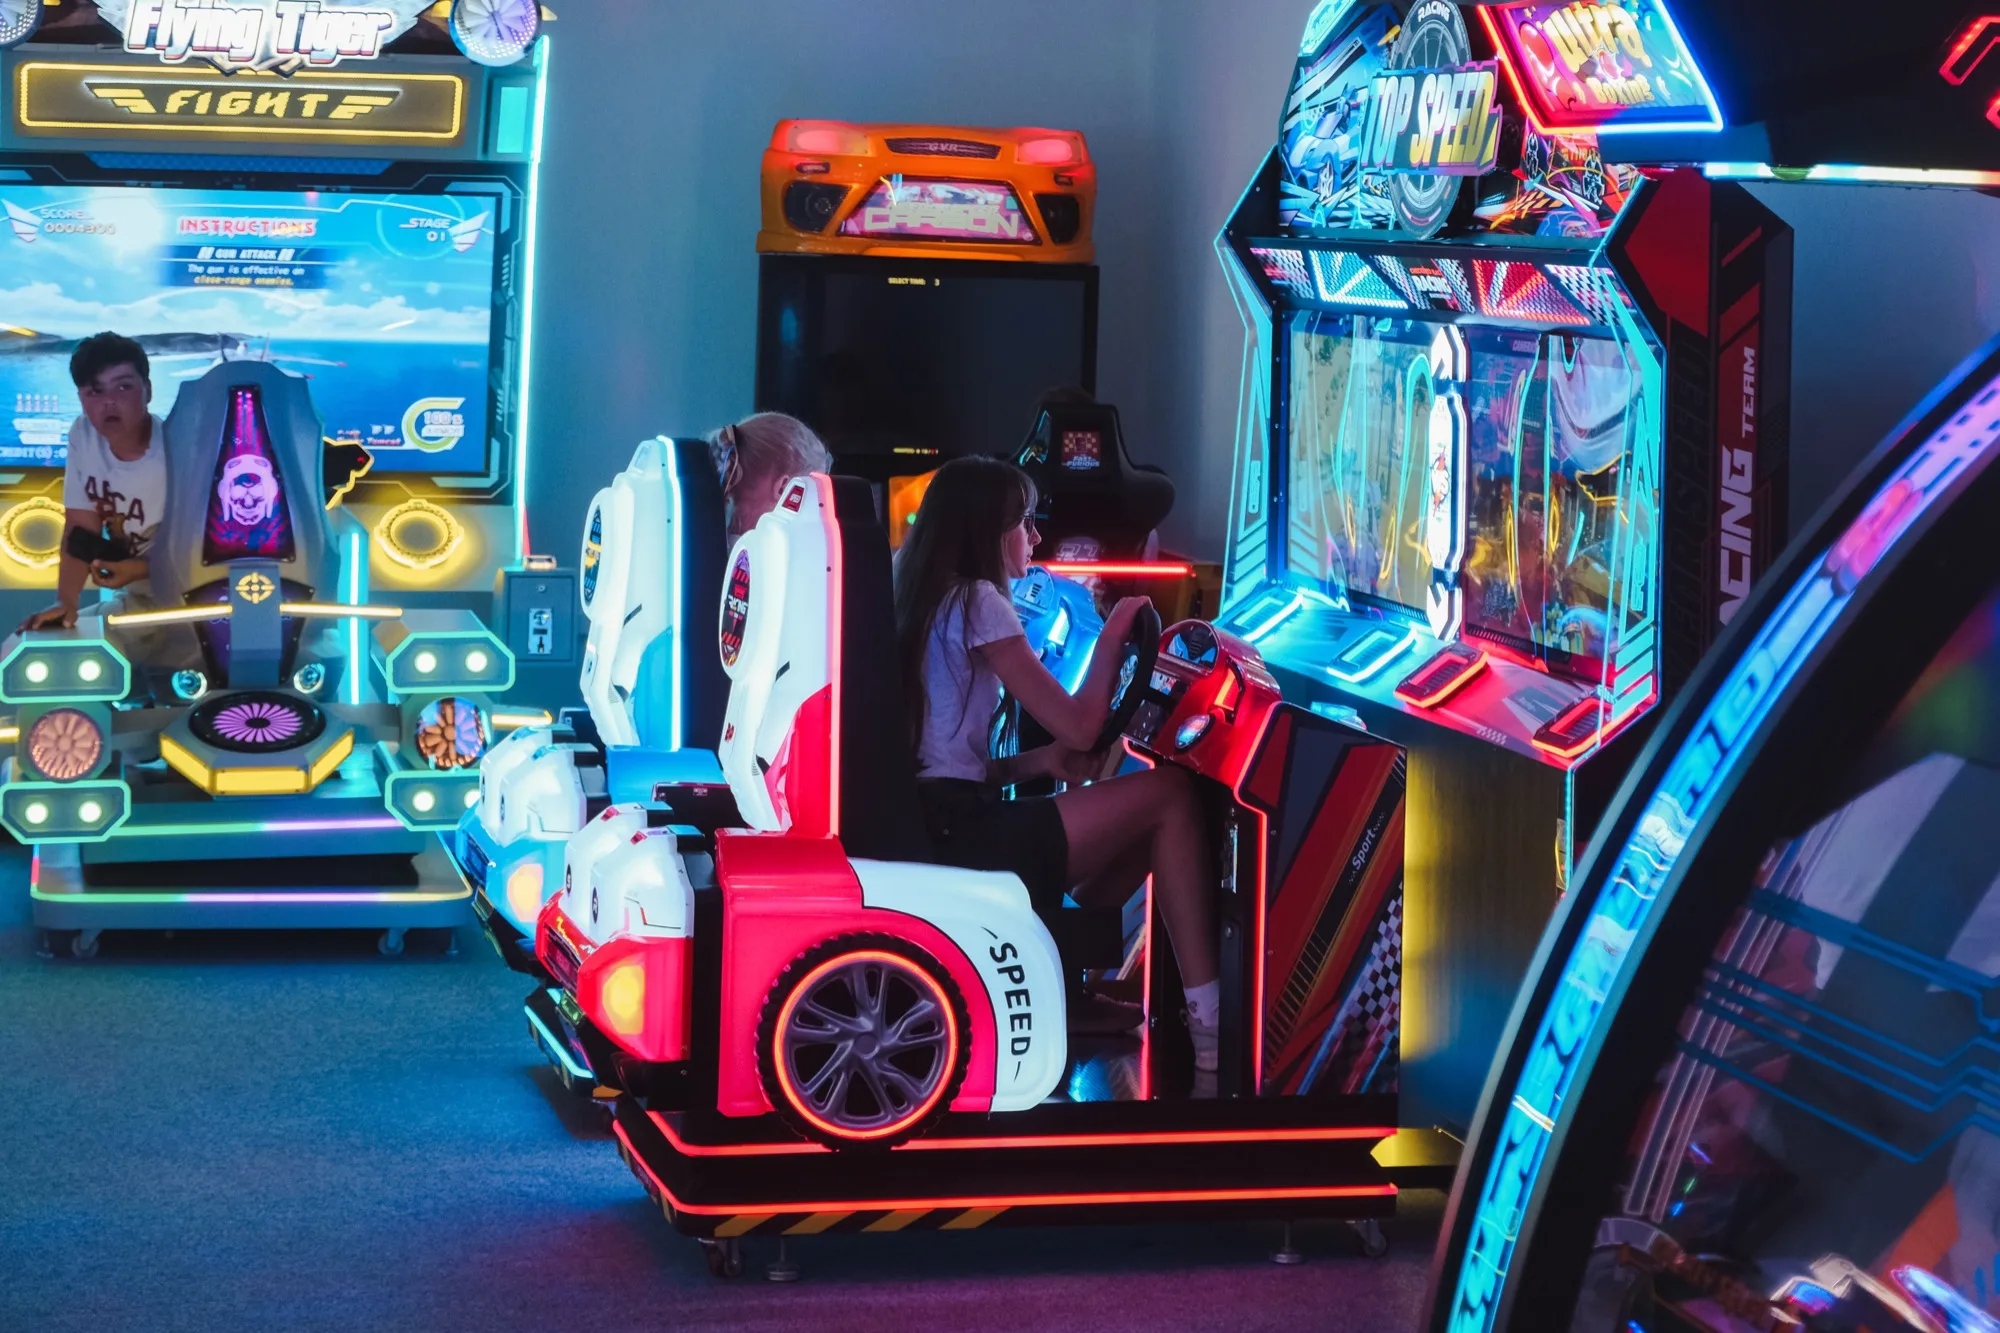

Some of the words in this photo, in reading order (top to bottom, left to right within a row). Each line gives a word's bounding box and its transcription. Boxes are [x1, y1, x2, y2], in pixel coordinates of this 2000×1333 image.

[1417, 1, 1450, 23] RACING
[126, 0, 264, 62] Flying
[275, 1, 393, 64] Tiger
[165, 91, 330, 119] FIGHT
[1361, 75, 1416, 168] TOP
[1409, 71, 1497, 168] SPEED
[179, 218, 316, 236] INSTRUCTIONS
[402, 217, 451, 229] STAGE
[426, 230, 446, 242] 01
[239, 248, 278, 261] ATTACK
[188, 263, 205, 274] The
[1719, 444, 1753, 627] ACING
[1742, 346, 1756, 438] TEAM
[1352, 828, 1375, 870] Sport
[989, 941, 1033, 1056] SPEED
